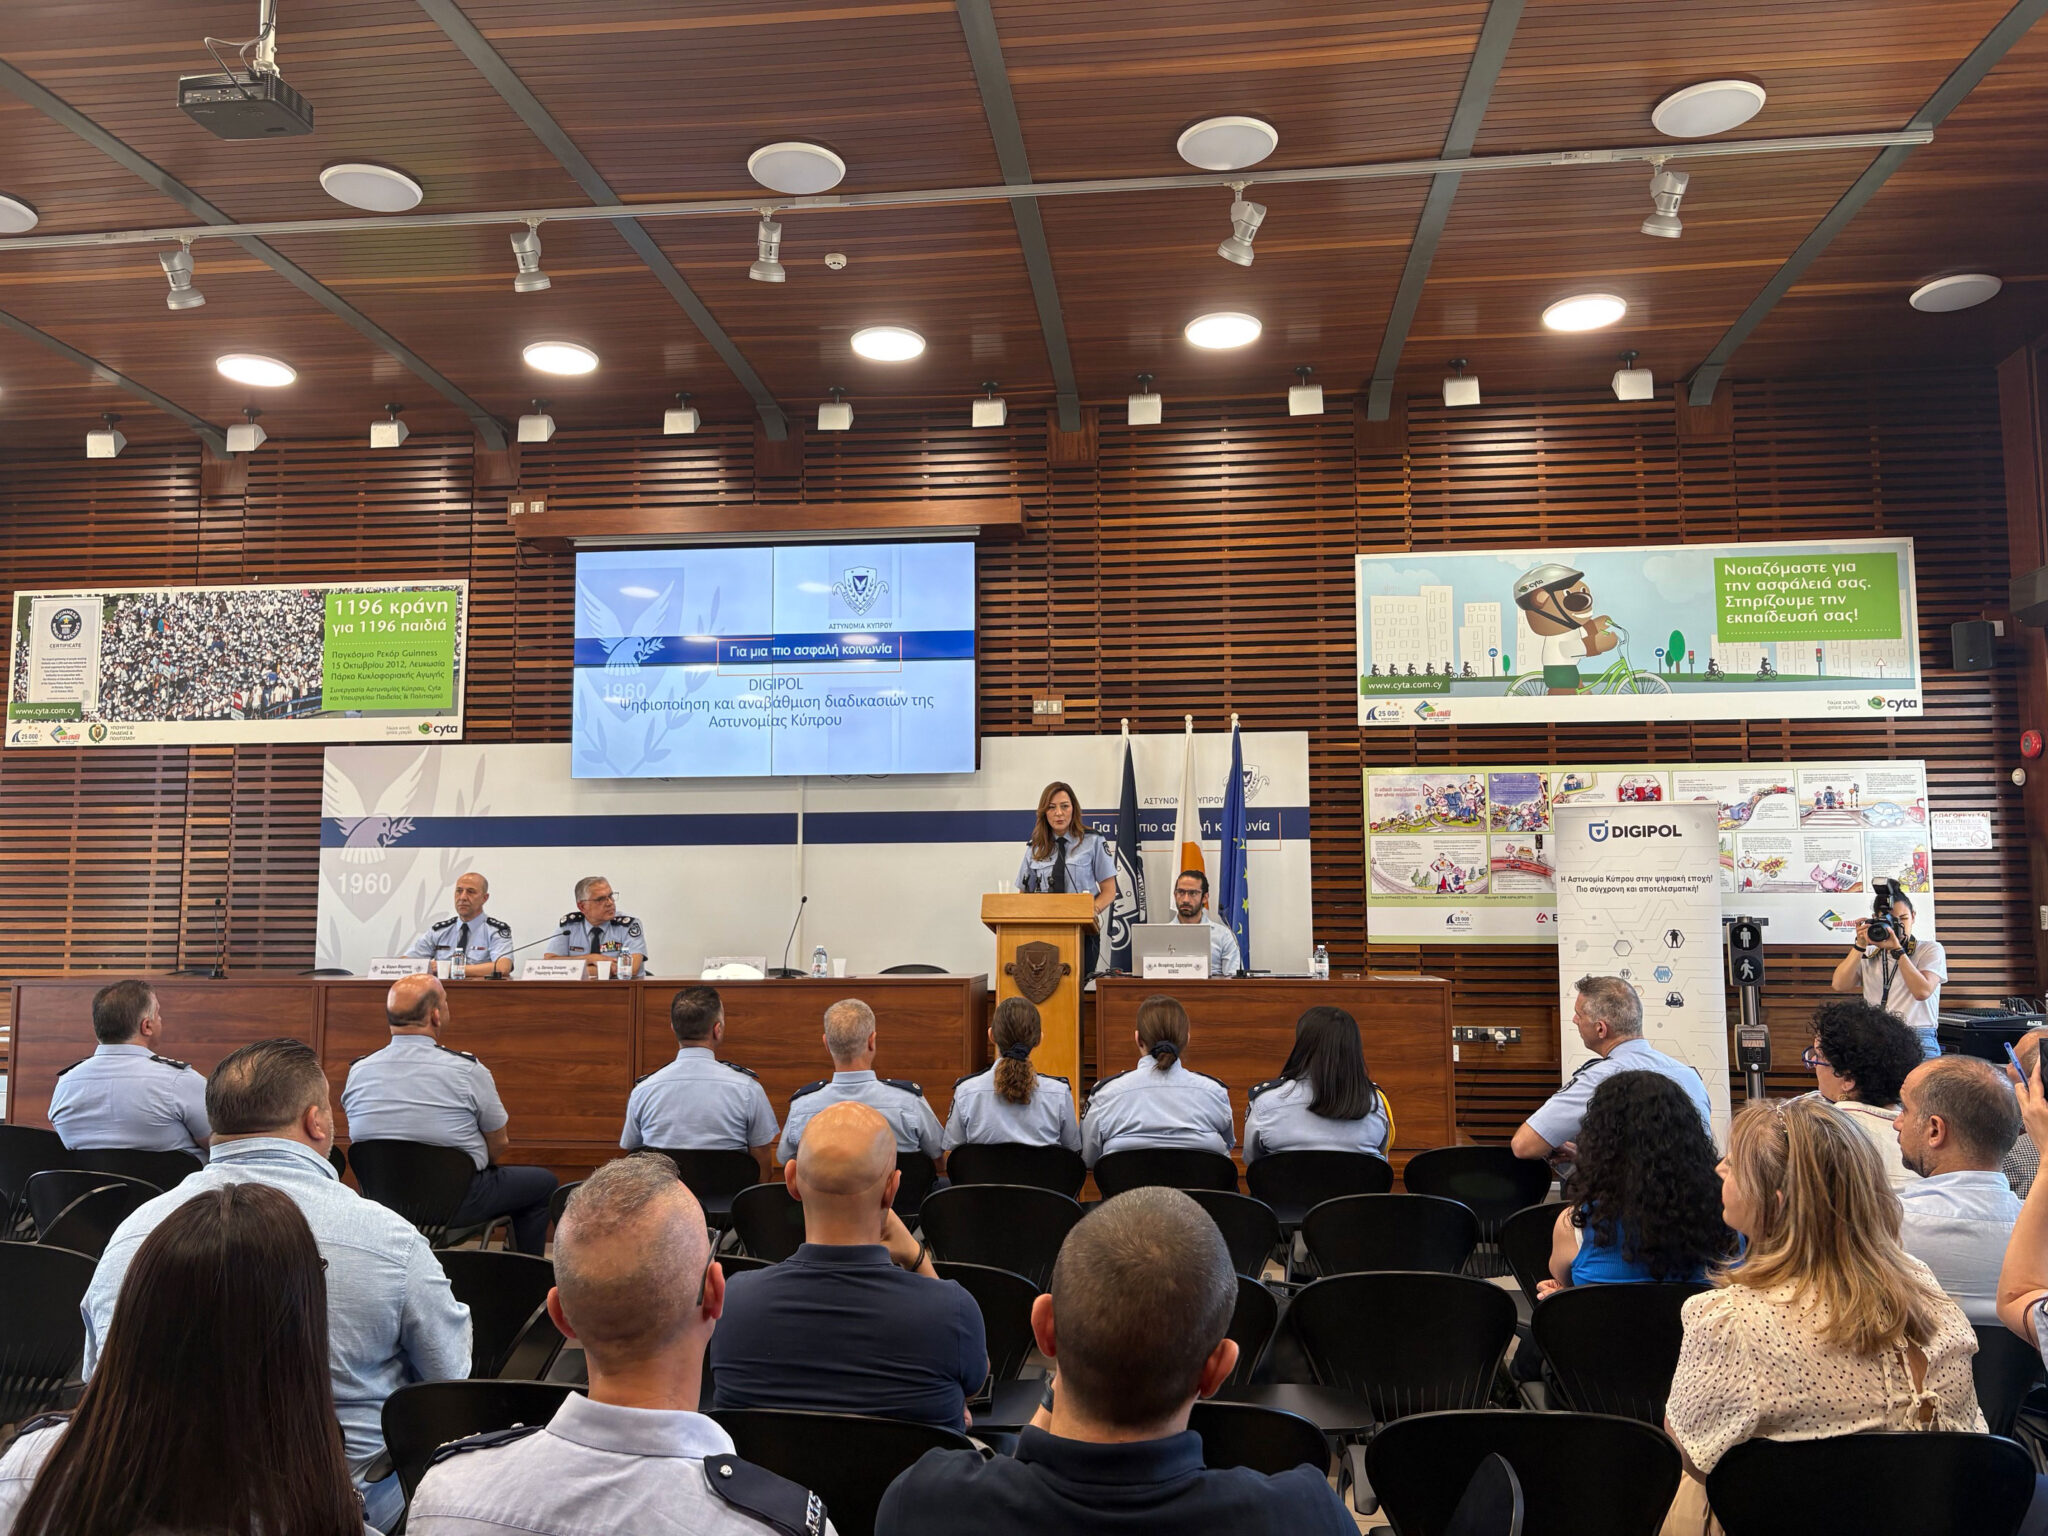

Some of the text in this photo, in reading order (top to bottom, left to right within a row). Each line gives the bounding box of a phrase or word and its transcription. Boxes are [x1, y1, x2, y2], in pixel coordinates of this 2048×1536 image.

[1724, 561, 1856, 578] Νοιαζόμαστε για
[1724, 577, 1871, 593] την ασφάλειά σας.
[335, 597, 448, 618] 1196 κράνη
[1725, 594, 1847, 610] Στηρίζουμε την
[1726, 607, 1858, 624] εκπαίδευσή σας!
[333, 618, 447, 637] για 1196 παιδιά
[332, 649, 438, 660] Παγκόσμιο Ρεκόρ Guinness
[730, 642, 893, 660] Για μια πιο ασφαλή κοινωνία
[343, 661, 384, 670] Οκτωβρίου
[386, 661, 407, 669] 2012,
[331, 672, 355, 682] Πάρκο
[602, 682, 646, 699] 1960
[749, 678, 803, 692] DIGIPOL
[1368, 681, 1443, 691] www.cyta.com.cy
[620, 692, 934, 714] Ψηφιοποίηση και αναβάθμιση διαδικασιών της
[1887, 698, 1918, 712] cyta
[15, 707, 75, 716] www.cyta.com.cy
[709, 714, 842, 729] Αστυνομίας Κύπρου
[433, 724, 458, 736] cyta
[1143, 796, 1224, 805] ΑΣΤΥΝΟ ΥΠΡΟΥ
[1139, 823, 1158, 833] πιο
[1612, 824, 1682, 838] DIGIPOL
[337, 872, 392, 894] 1960
[1568, 875, 1604, 884] Αστυνομία
[1606, 875, 1633, 884] Κύπρου
[1636, 876, 1653, 884] στην
[1655, 875, 1686, 884] ψηφιακή
[1687, 874, 1713, 884] εποχή!
[1590, 885, 1625, 894] σύγχρονη
[1639, 885, 1699, 894] αποτελεσματική!
